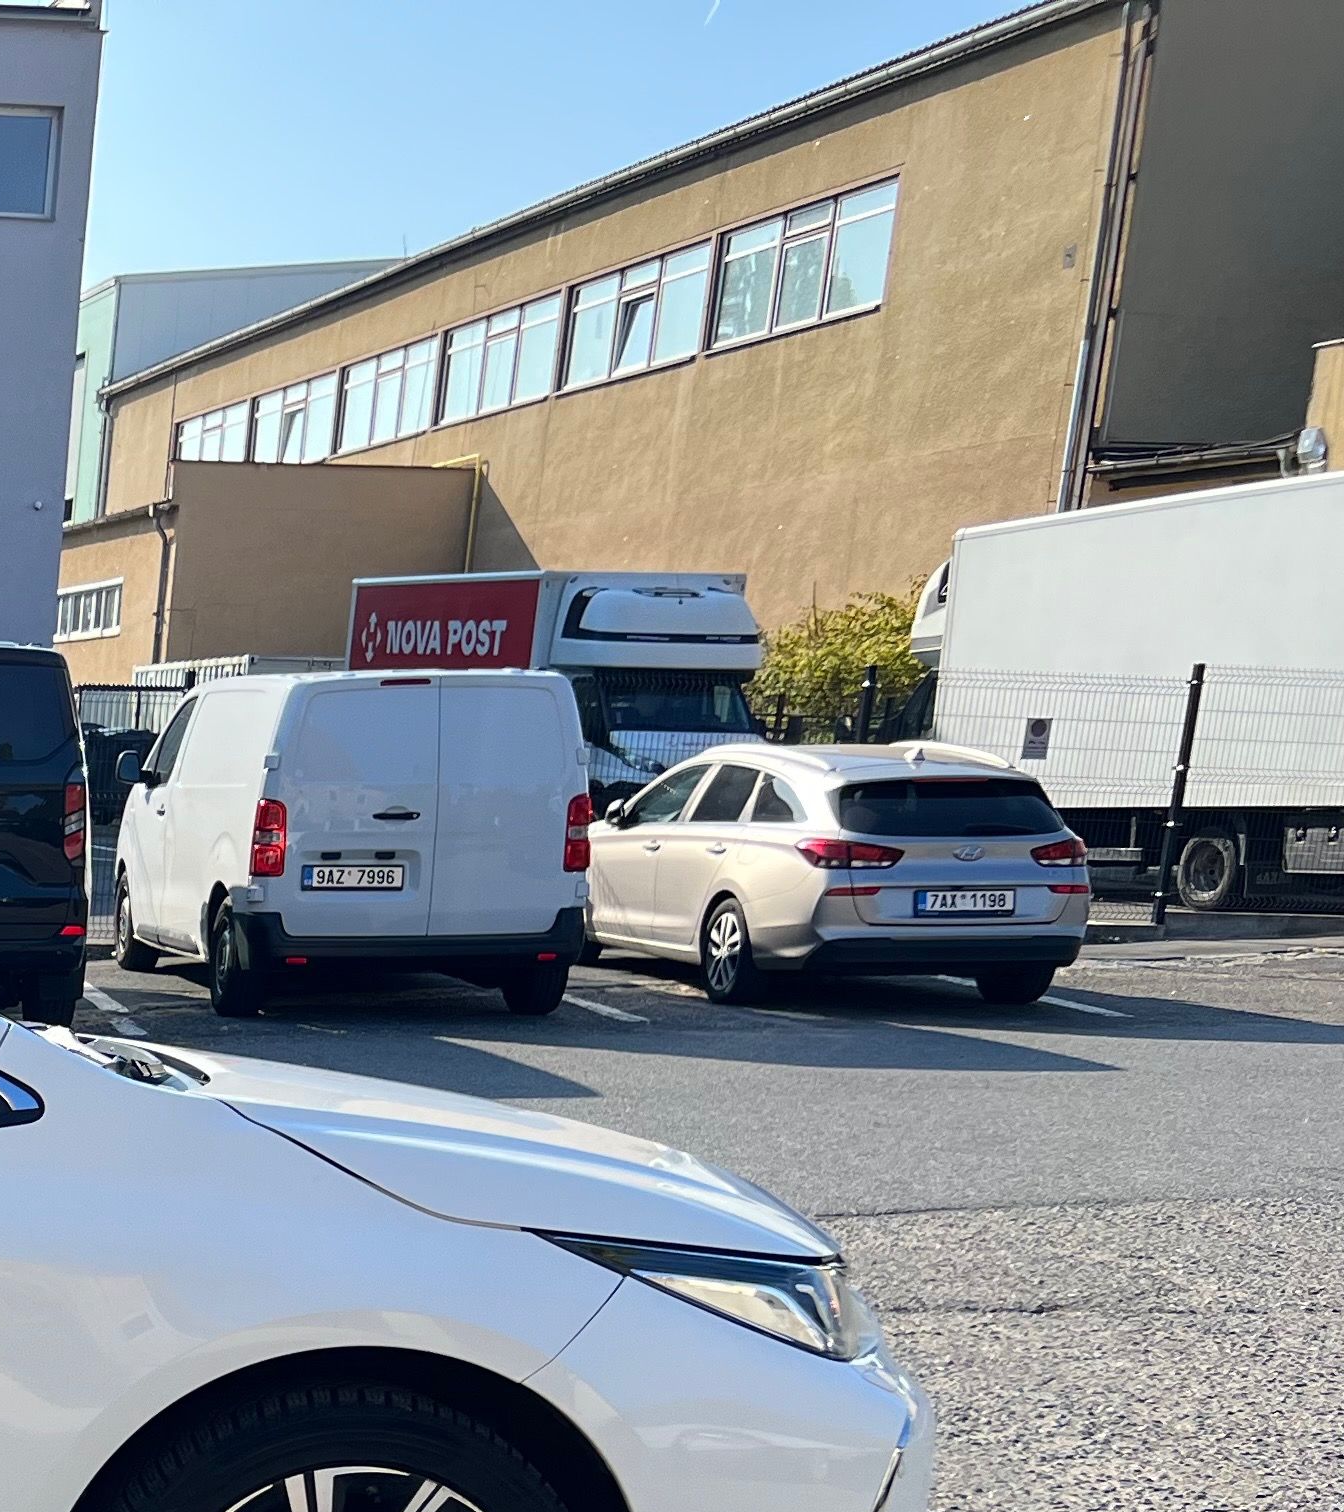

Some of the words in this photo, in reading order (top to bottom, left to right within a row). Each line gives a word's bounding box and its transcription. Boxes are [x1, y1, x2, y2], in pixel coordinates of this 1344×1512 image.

[385, 620, 441, 655] NOVA
[446, 619, 508, 657] POST
[316, 869, 345, 885] 9AZ
[357, 869, 395, 885] 7996
[929, 894, 958, 909] 7AX
[970, 893, 1006, 908] 1198
